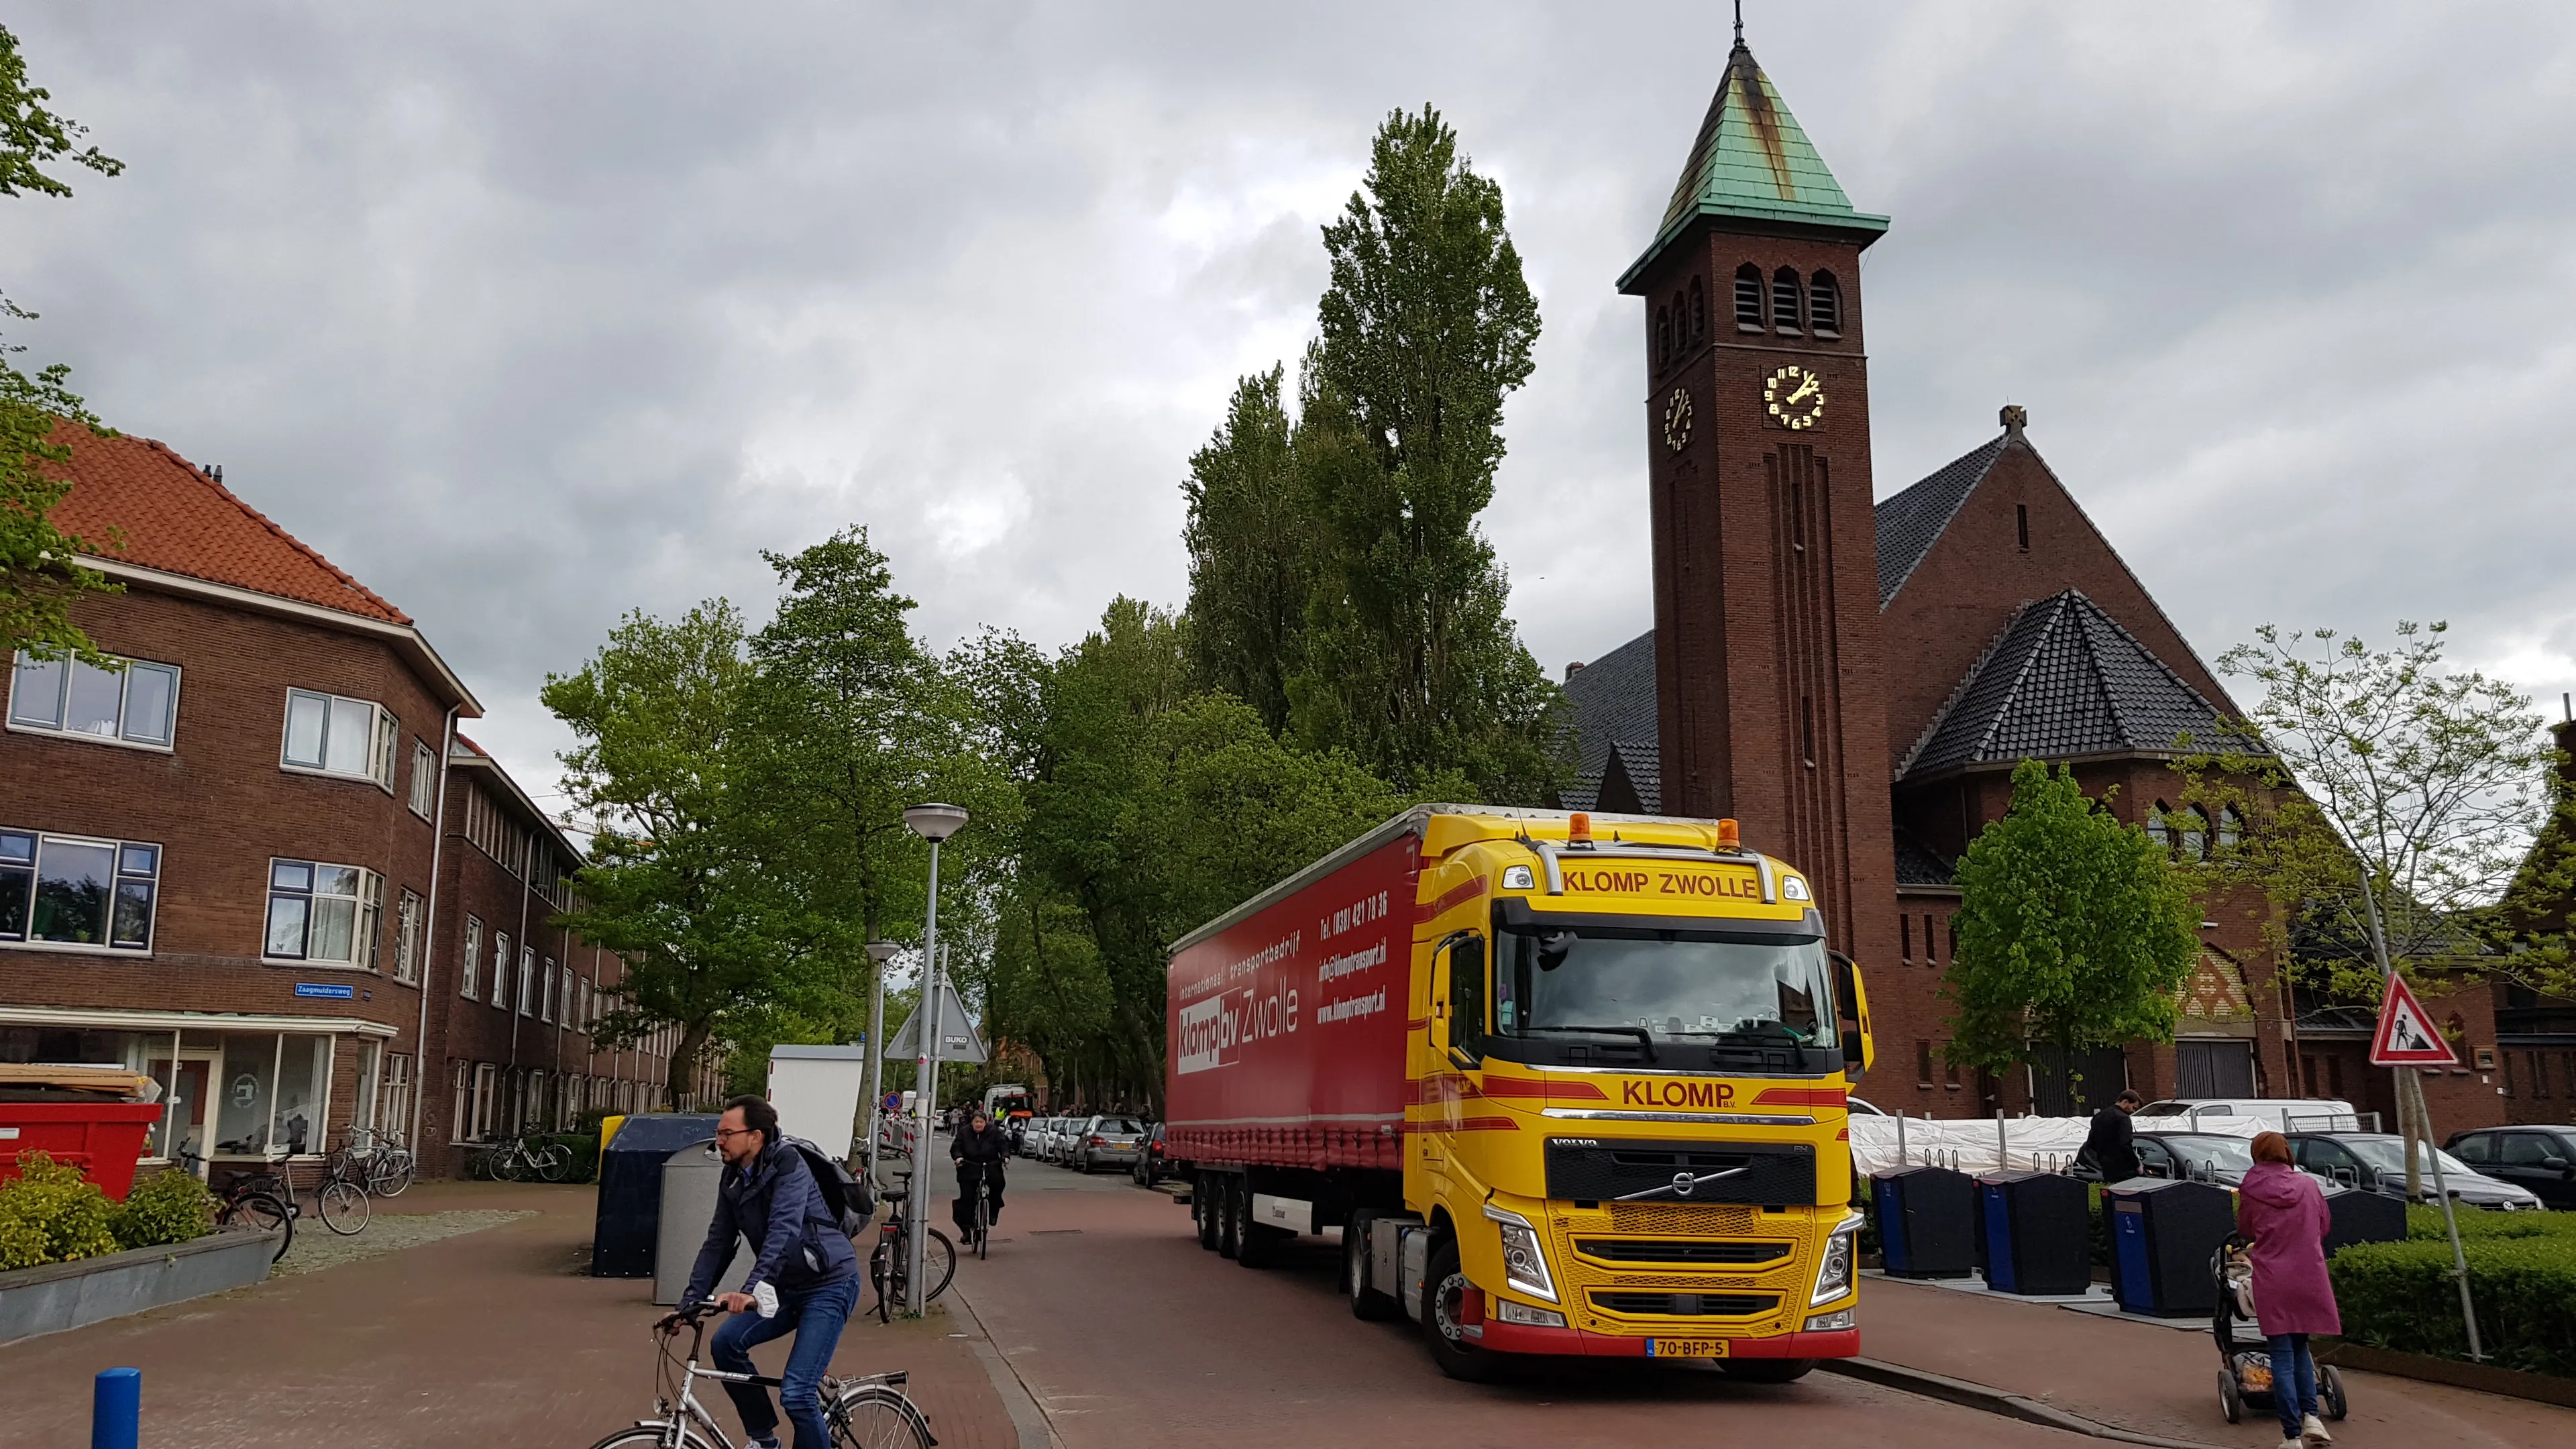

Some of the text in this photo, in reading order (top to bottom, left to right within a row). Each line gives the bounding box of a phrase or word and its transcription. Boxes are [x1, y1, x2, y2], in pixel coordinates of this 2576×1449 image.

[1777, 368, 1785, 379] 11
[1788, 366, 1799, 377] 12
[1803, 370, 1808, 380] 1
[1767, 378, 1776, 388] 10
[1764, 390, 1773, 401] 9
[1815, 394, 1824, 405] 3
[1769, 403, 1779, 415] 8
[1811, 406, 1821, 417] 4
[1780, 414, 1788, 425] 7
[1791, 418, 1800, 429] 6
[1803, 415, 1811, 426] 5
[1562, 871, 1758, 899] KLOMP ZWOLLE
[1320, 890, 1388, 941] Tel. (038) 421 78 36
[1318, 935, 1387, 983] info@klomptransport.nl
[1179, 928, 1301, 1002] internationaal transportbedrijf
[298, 985, 351, 996] Zaagmuldersweg
[1241, 976, 1298, 1043] Zwolle
[1317, 984, 1385, 1024] www.klomptransport.nl
[1622, 1080, 1734, 1108] KLOMP
[1551, 1138, 1597, 1147] VOLVO
[1658, 1341, 1723, 1355] 70-BFP-5
